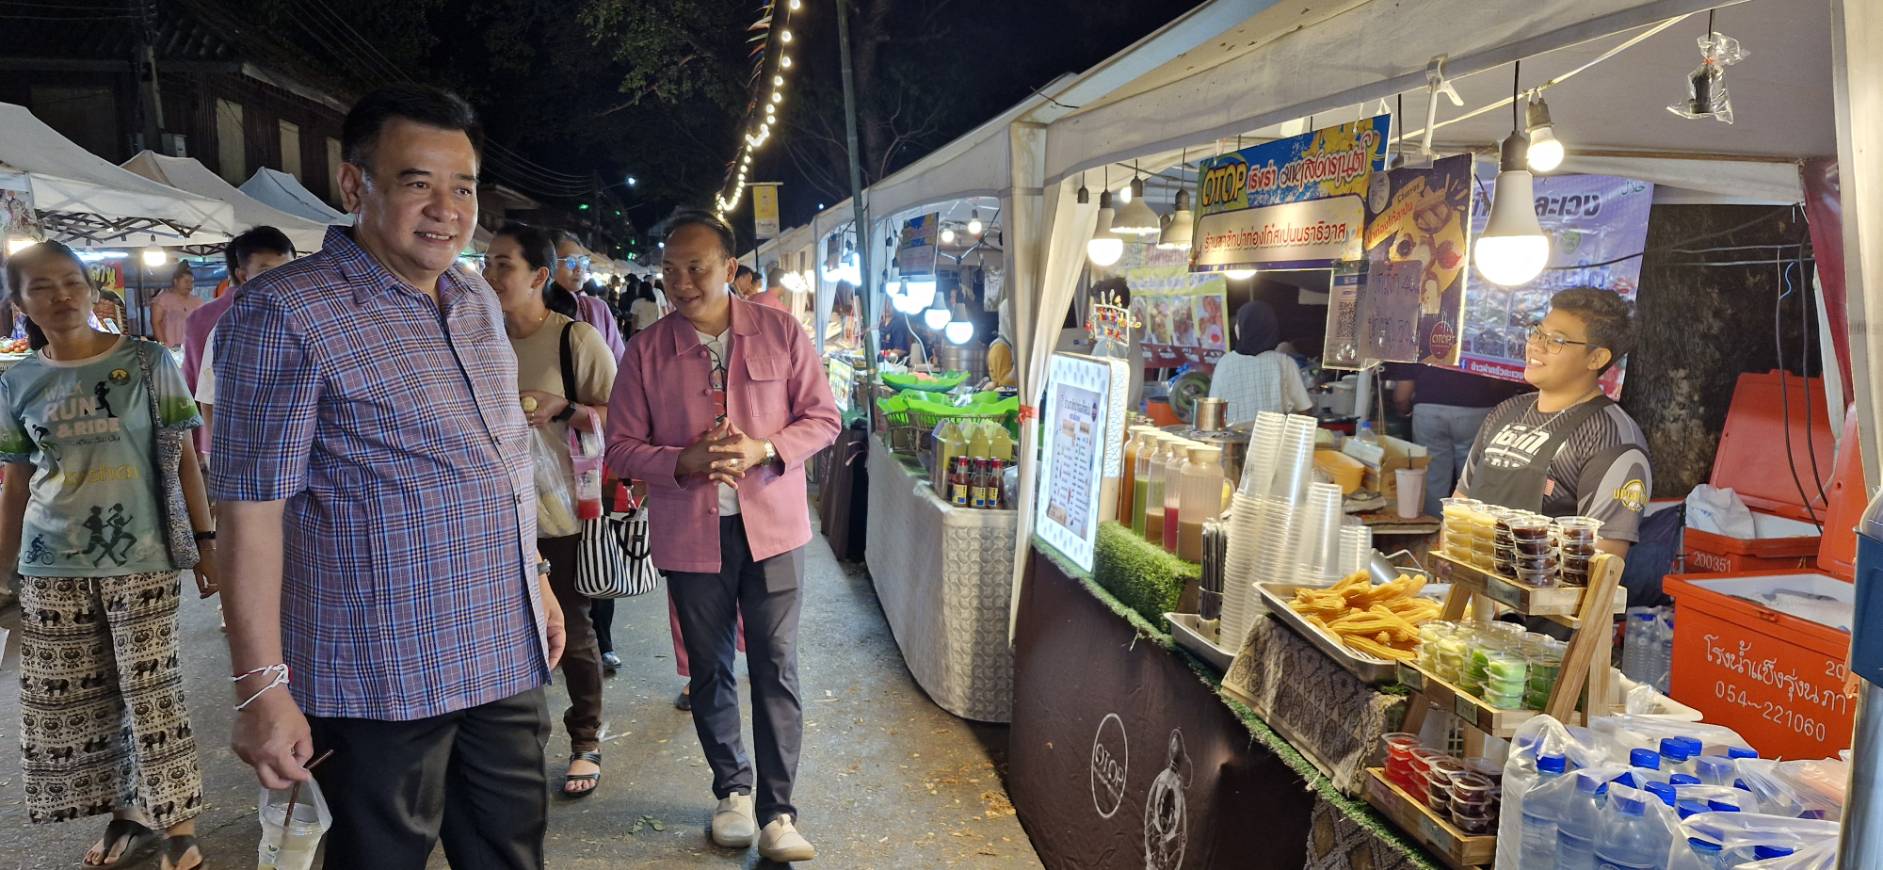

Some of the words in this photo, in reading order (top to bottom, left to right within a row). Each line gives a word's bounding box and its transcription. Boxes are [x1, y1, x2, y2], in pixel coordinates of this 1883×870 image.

[1202, 161, 1248, 207] OTOP
[42, 397, 97, 424] RUN
[1693, 551, 1732, 573] 200351
[1095, 743, 1124, 787] OTOP
